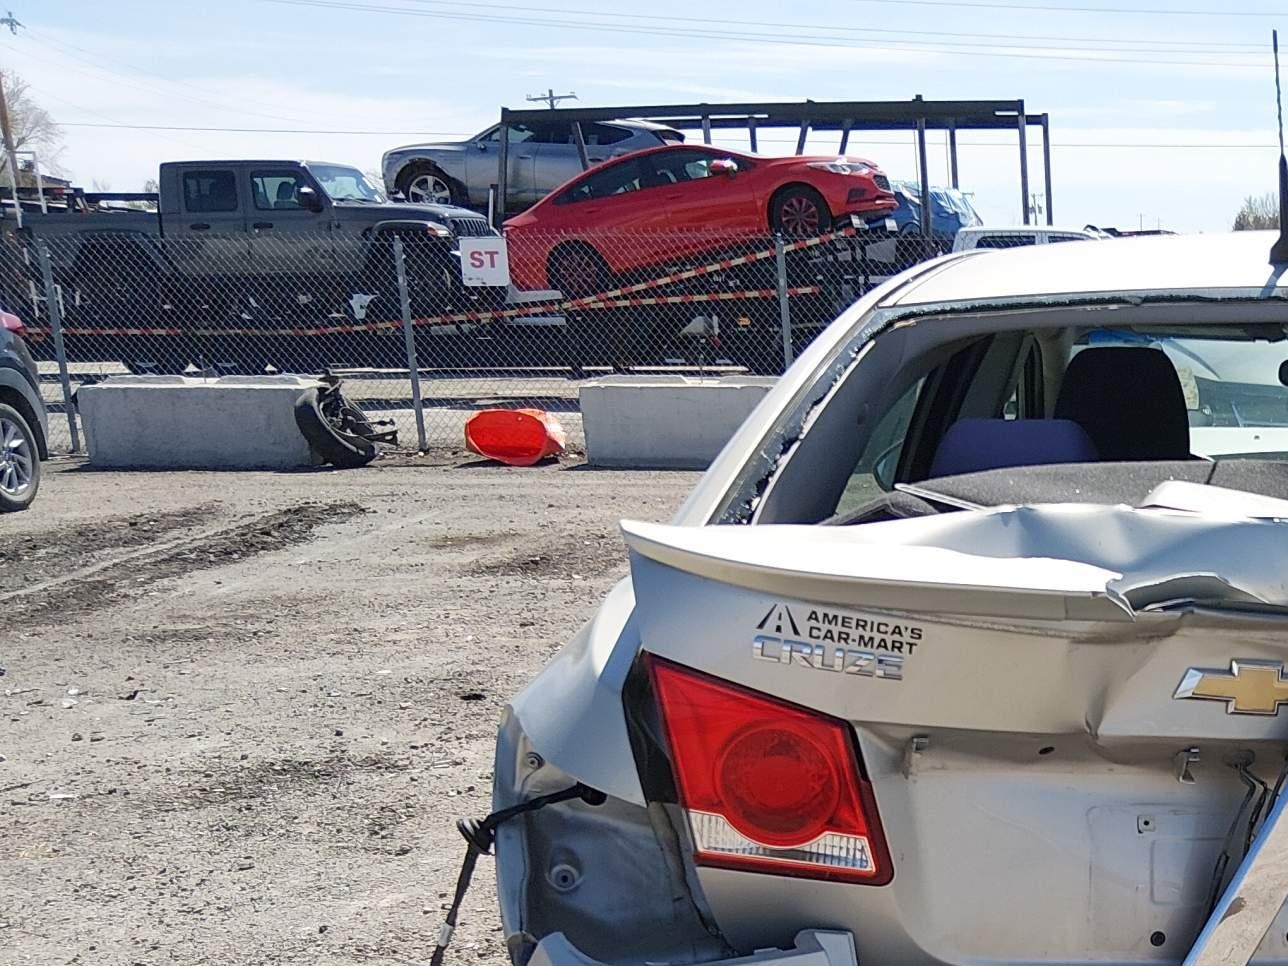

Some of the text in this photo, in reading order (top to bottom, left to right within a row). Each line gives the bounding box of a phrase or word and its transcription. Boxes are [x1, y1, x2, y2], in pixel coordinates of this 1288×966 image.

[470, 250, 499, 269] ST
[806, 610, 923, 641] AMERICA'S
[808, 626, 918, 655] CAR-MART
[752, 634, 904, 681] CRUZE
